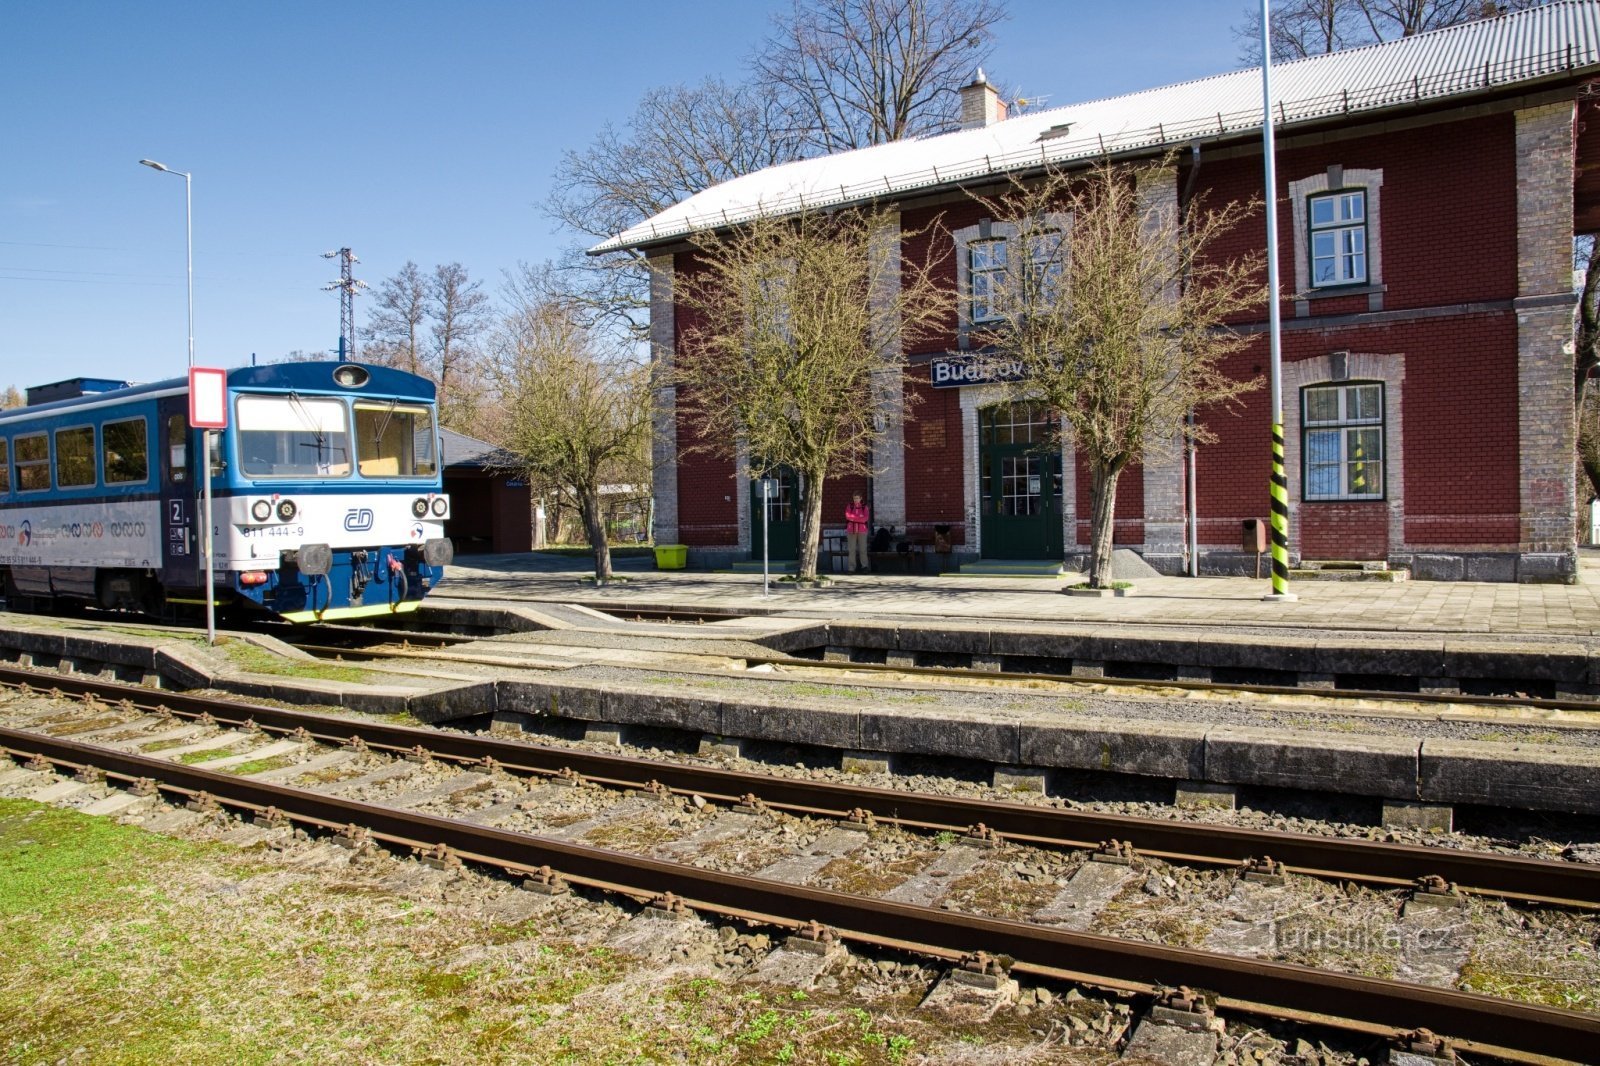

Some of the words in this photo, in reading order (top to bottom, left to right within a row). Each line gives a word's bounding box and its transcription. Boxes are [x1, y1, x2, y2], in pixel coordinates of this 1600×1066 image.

[173, 503, 181, 520] 2
[214, 526, 220, 536] 2
[243, 527, 263, 538] 811
